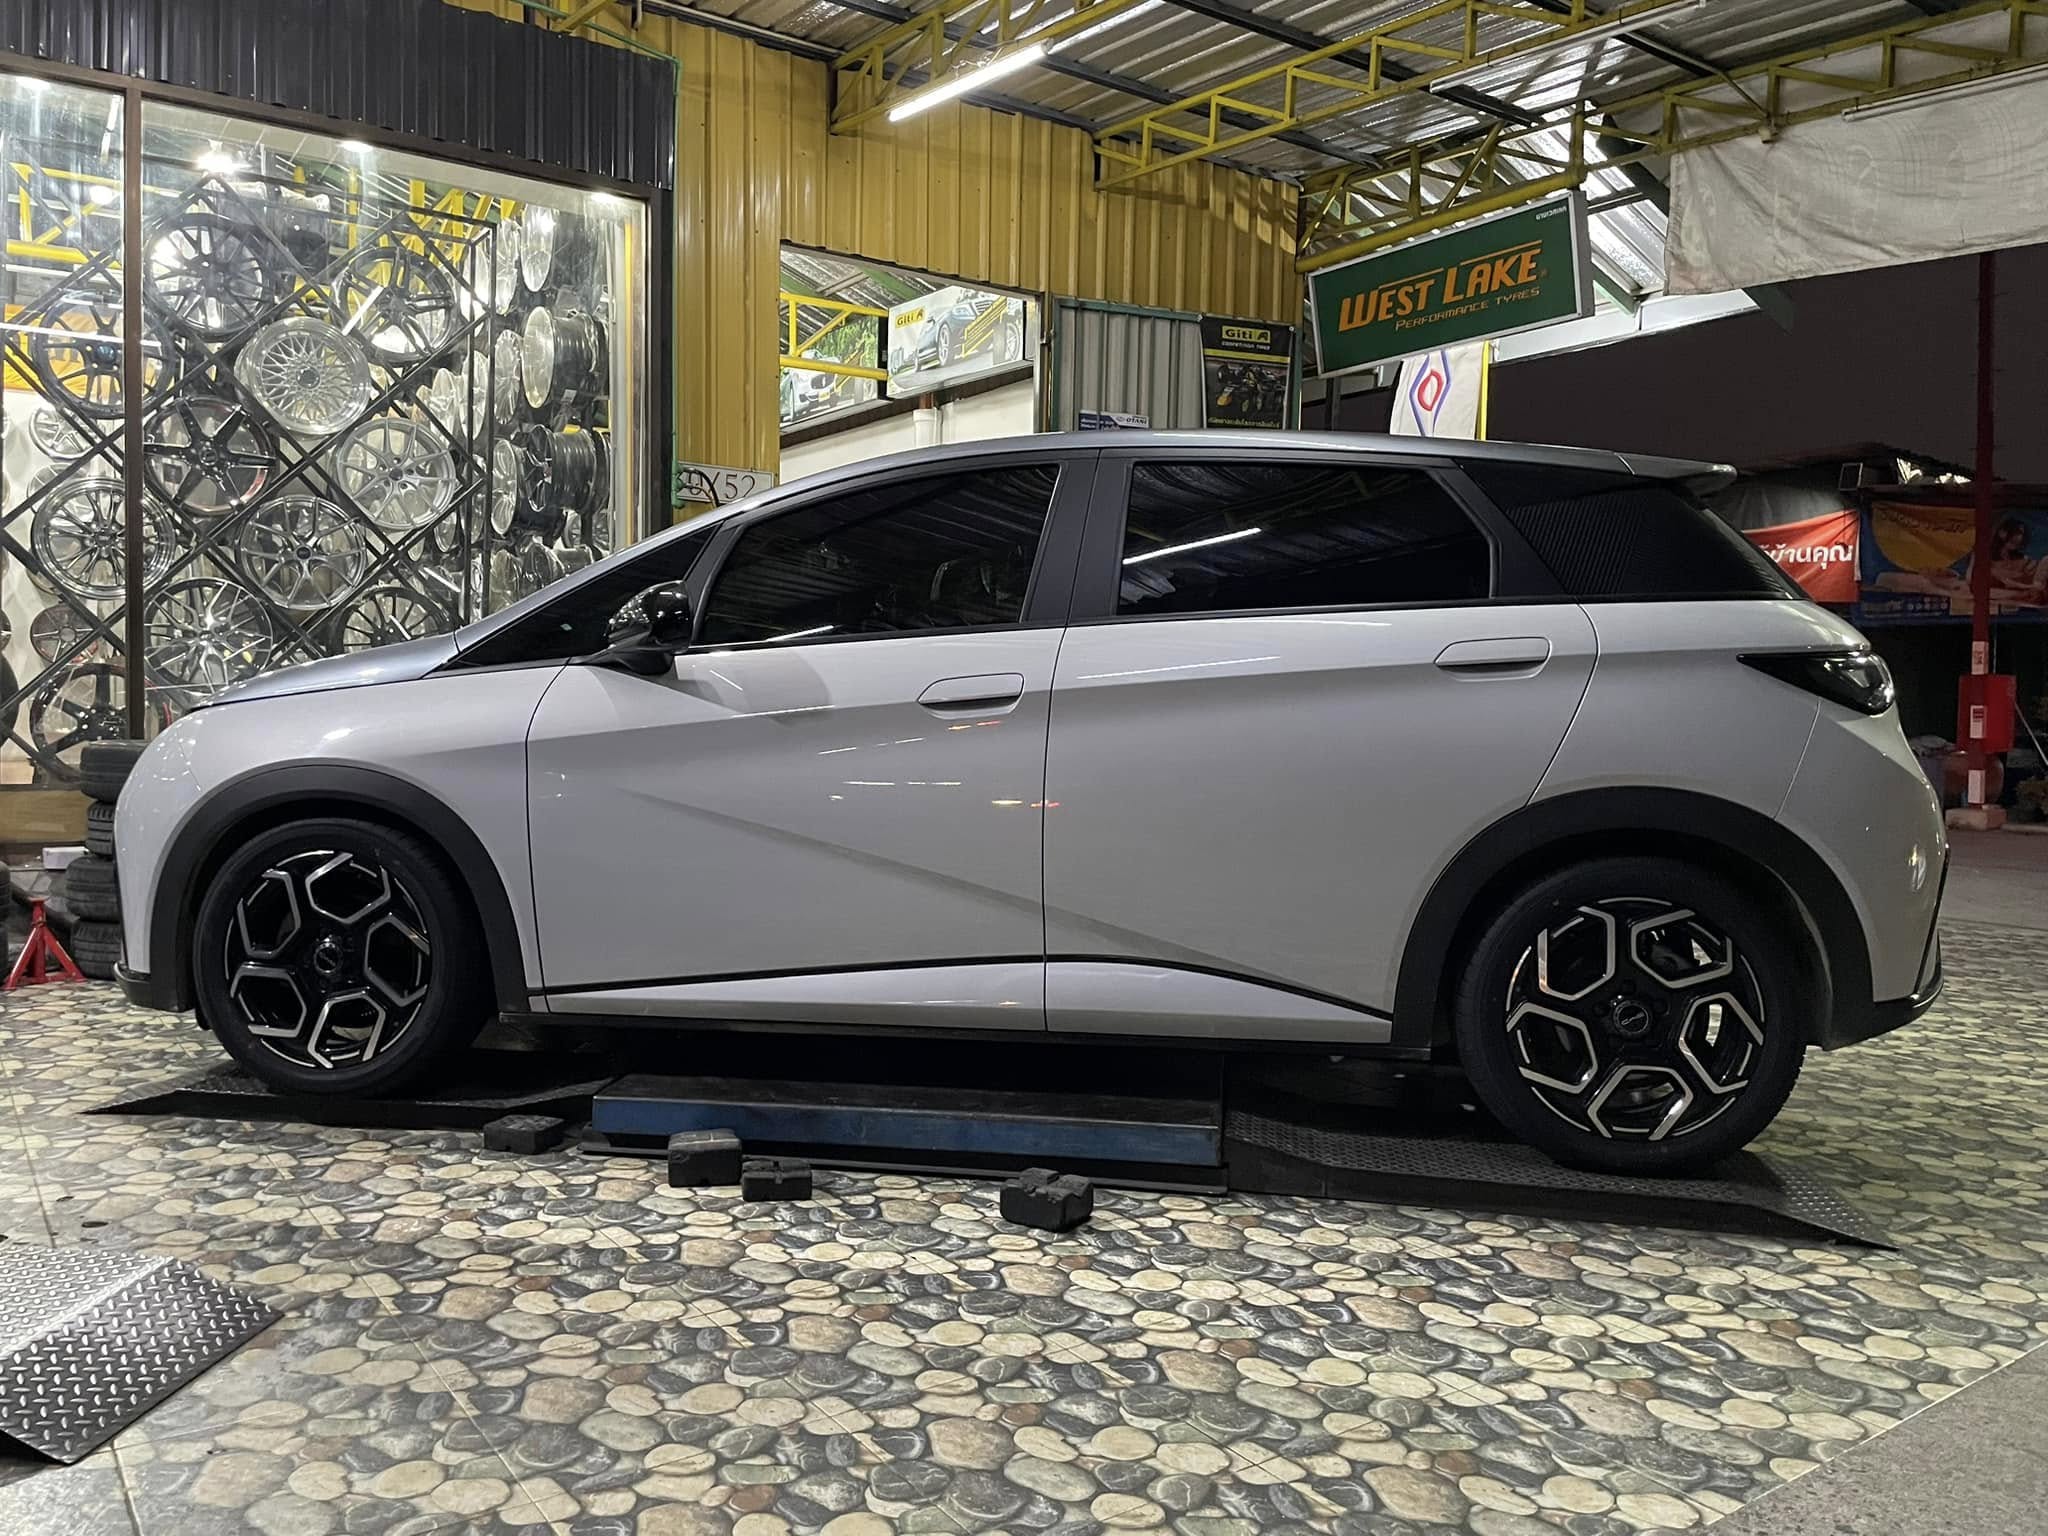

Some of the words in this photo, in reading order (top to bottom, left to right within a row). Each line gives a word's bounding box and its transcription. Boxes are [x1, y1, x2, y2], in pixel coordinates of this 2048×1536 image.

[1338, 279, 1435, 332] WEST
[1442, 248, 1543, 303] LAKE
[1395, 300, 1489, 331] PERFORMANCE
[1497, 287, 1541, 305] TYRES
[1225, 329, 1252, 339] Giti
[1759, 543, 1853, 570] บ้านคุณ
